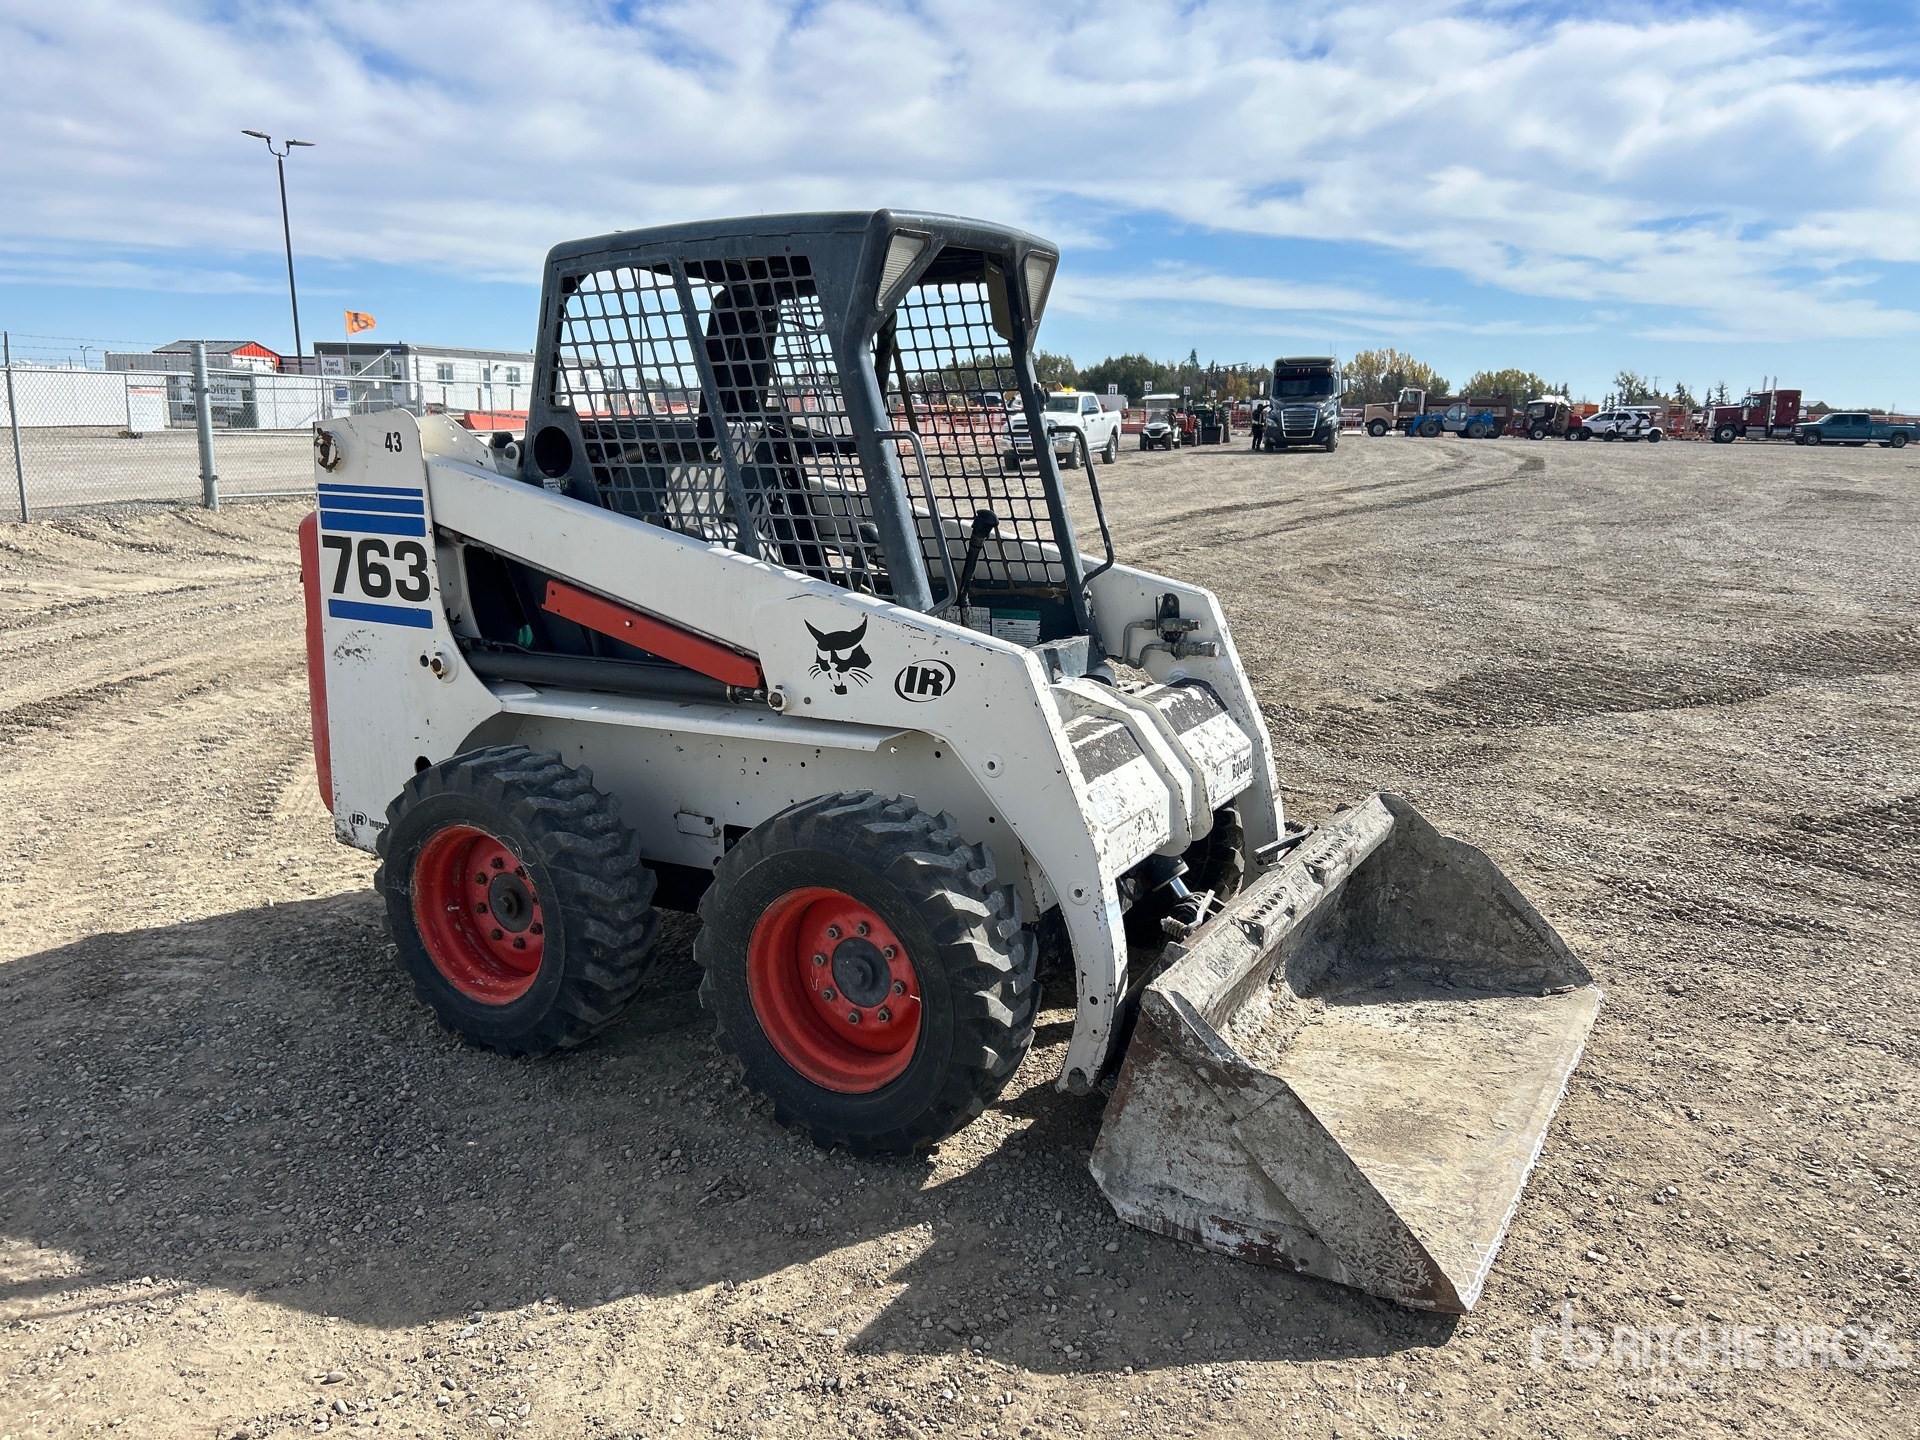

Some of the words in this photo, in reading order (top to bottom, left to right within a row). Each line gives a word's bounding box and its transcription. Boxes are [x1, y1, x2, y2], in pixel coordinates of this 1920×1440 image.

[324, 359, 339, 367] Yard
[323, 367, 342, 375] Office
[1109, 387, 1116, 395] 11
[1145, 382, 1152, 391] 12
[384, 431, 403, 453] 43
[322, 535, 431, 602] 763
[903, 665, 945, 697] IR
[351, 813, 365, 826] IR
